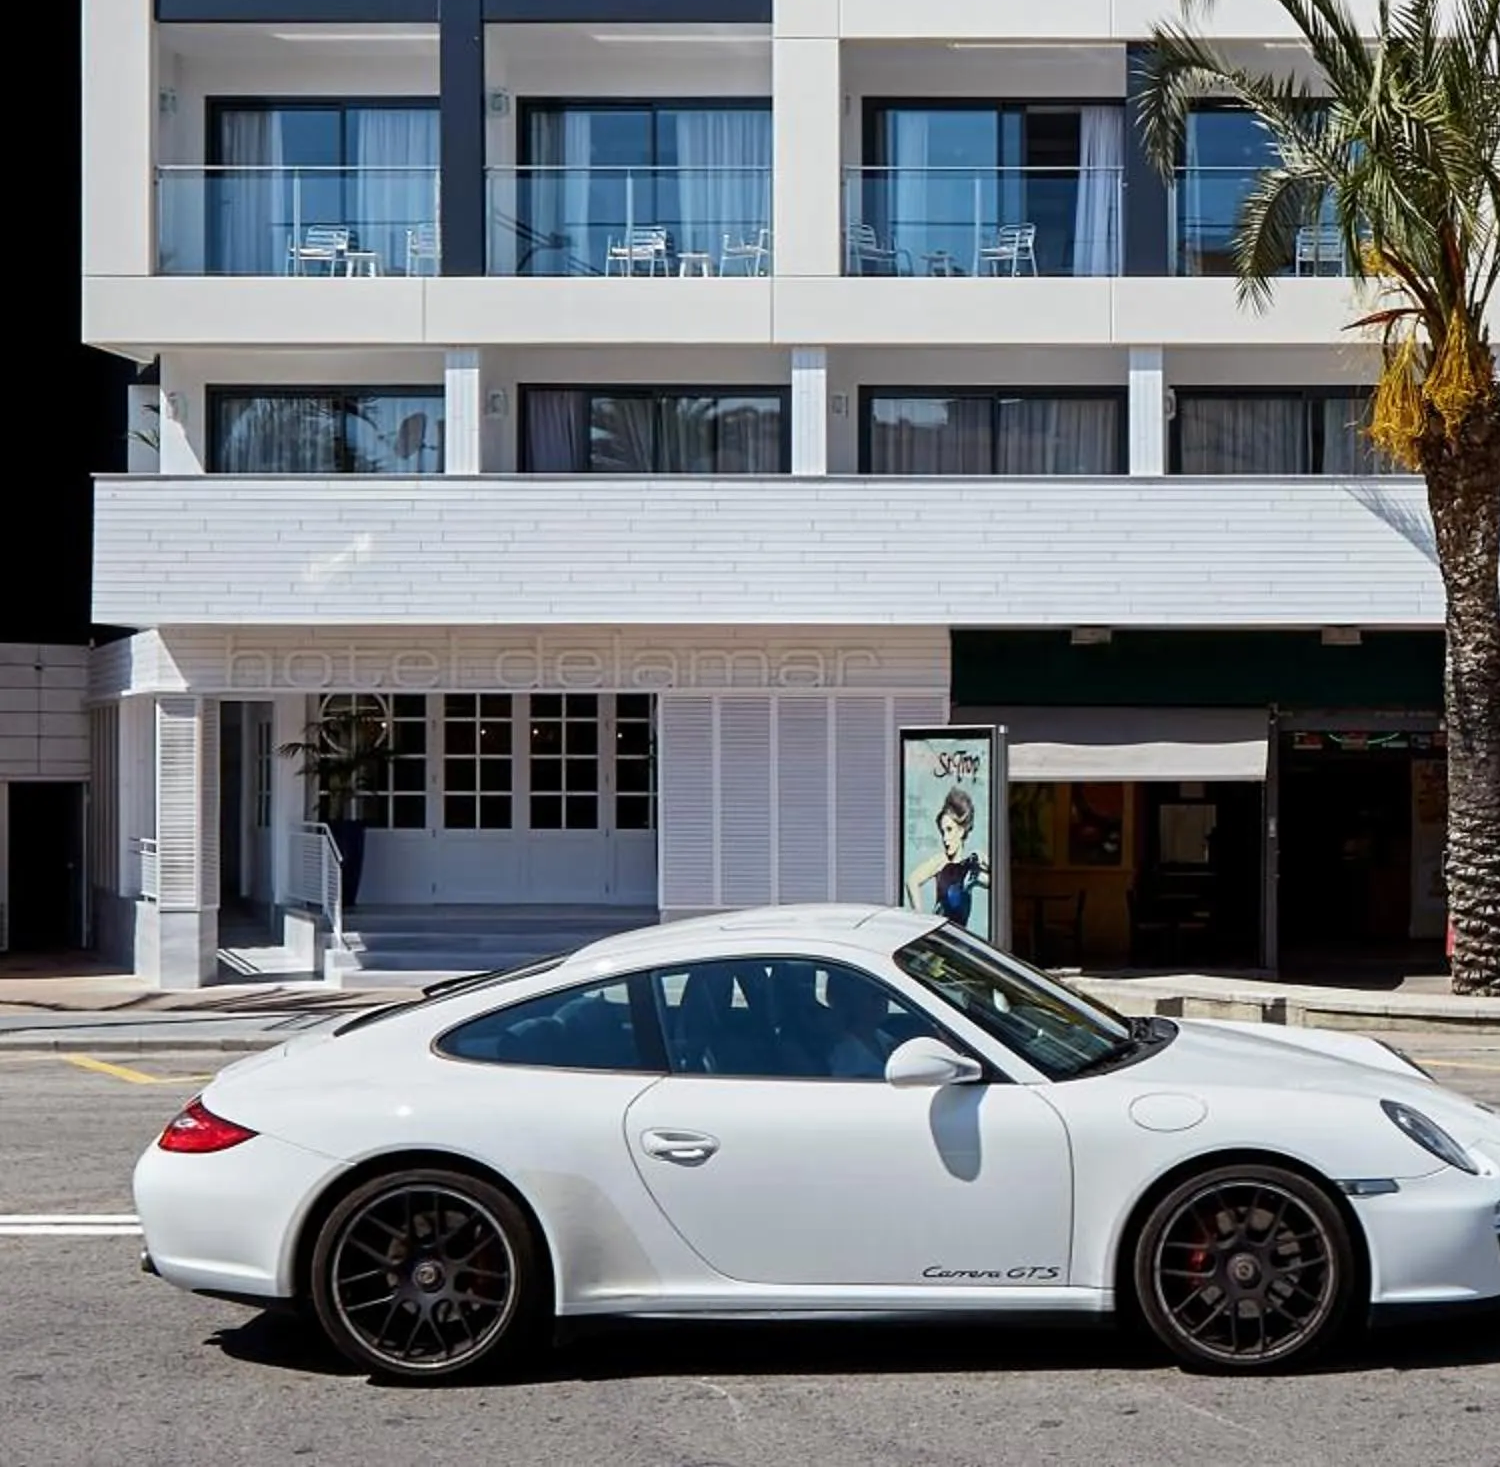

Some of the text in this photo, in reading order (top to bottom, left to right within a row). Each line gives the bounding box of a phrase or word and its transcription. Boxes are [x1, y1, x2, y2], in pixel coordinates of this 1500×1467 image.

[225, 630, 879, 689] hotel delamar
[922, 1265, 1061, 1280] Carrera GTS
